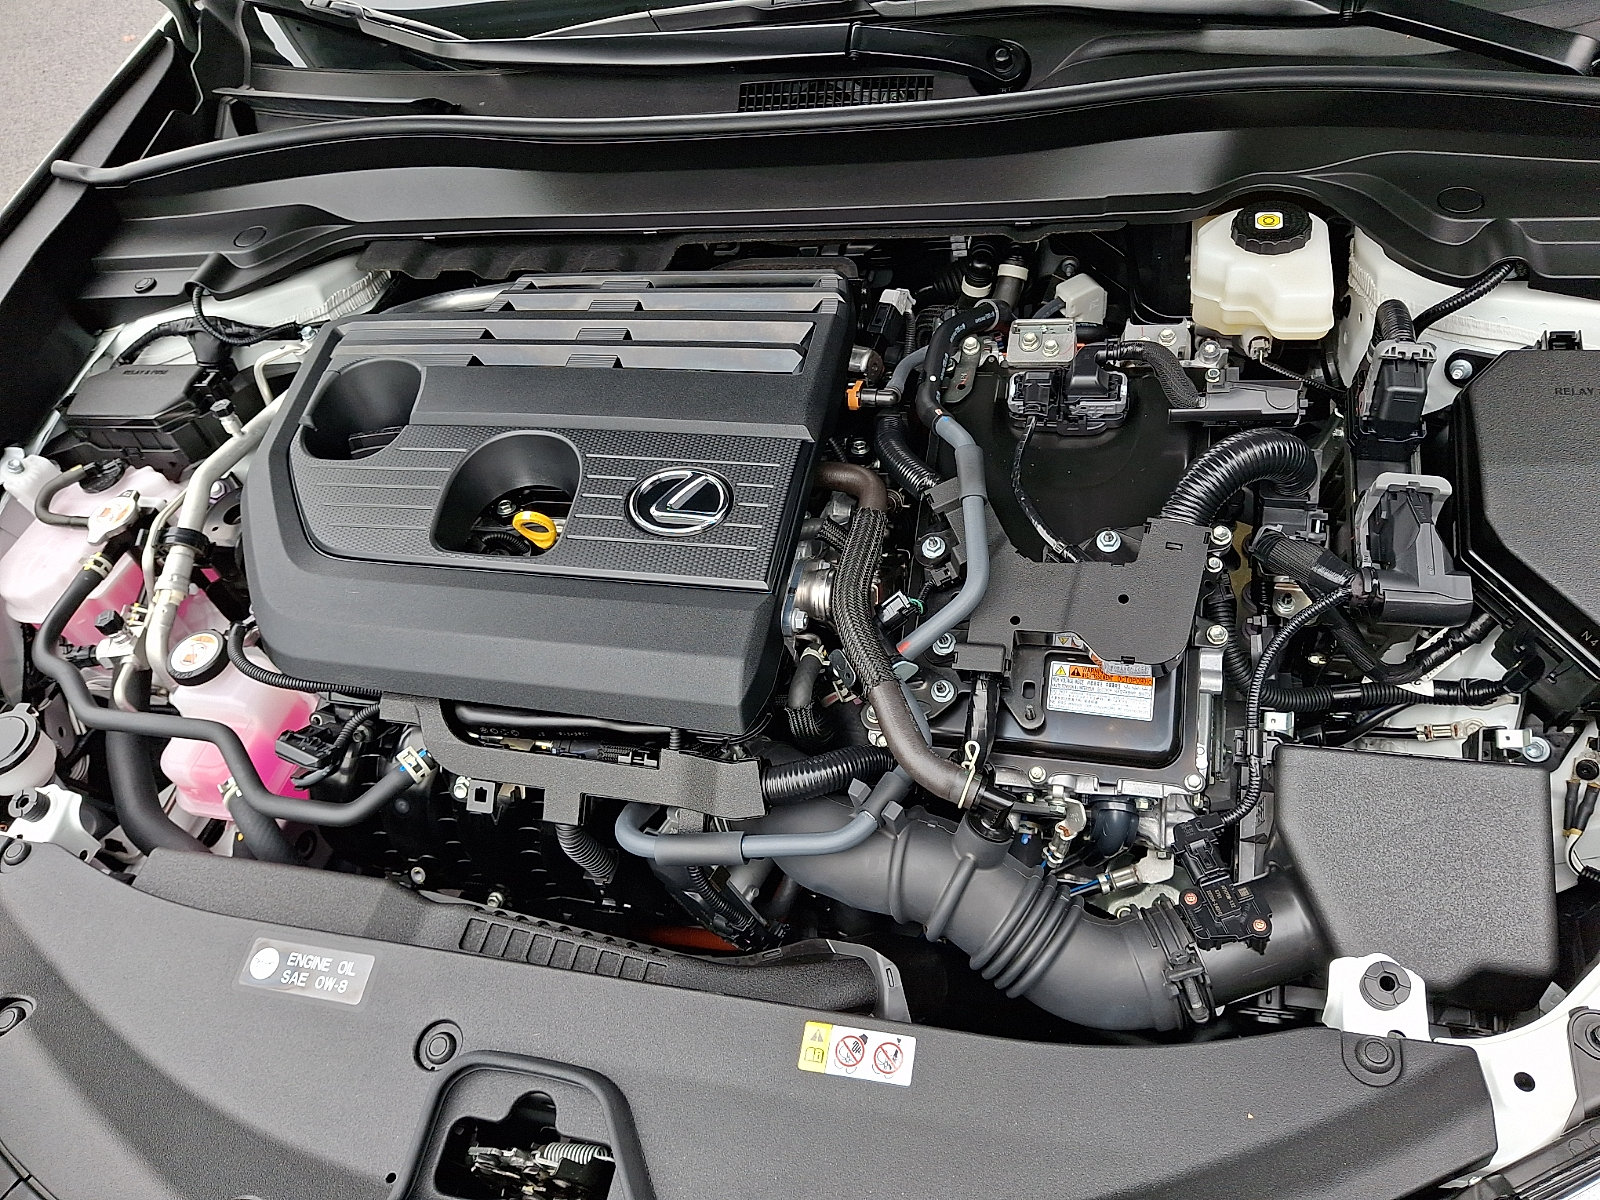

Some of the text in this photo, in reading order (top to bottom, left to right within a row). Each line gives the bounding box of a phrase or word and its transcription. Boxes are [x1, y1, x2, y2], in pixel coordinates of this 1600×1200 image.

[1554, 387, 1594, 396] RELAY
[287, 952, 333, 972] ENGINE
[337, 961, 356, 976] OIL
[280, 970, 348, 993] SAE 0W-8
